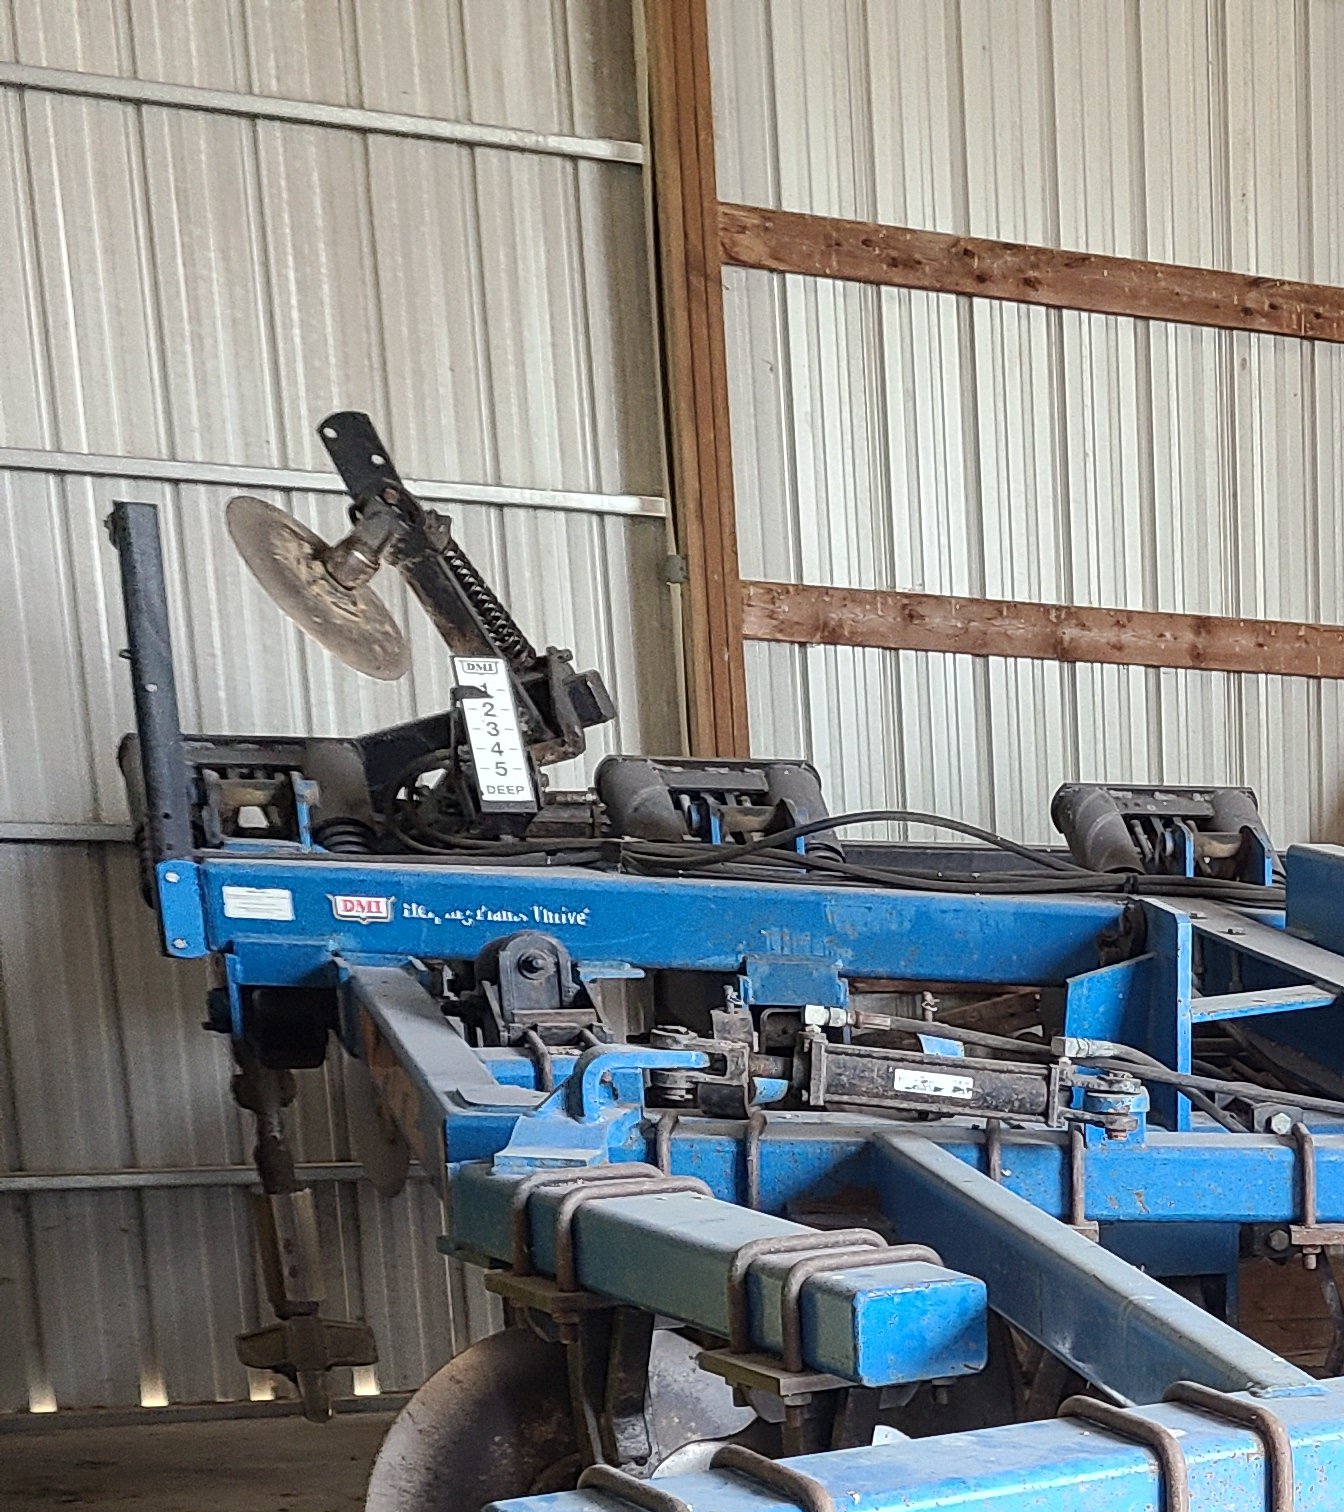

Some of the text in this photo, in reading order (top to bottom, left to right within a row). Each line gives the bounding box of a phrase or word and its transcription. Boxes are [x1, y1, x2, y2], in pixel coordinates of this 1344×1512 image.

[467, 663, 494, 671] DMI
[482, 702, 496, 717] 2
[486, 722, 500, 736] 3
[491, 742, 504, 756] 4
[495, 762, 508, 776] 5
[486, 785, 525, 795] DEEP
[341, 899, 382, 914] DMI
